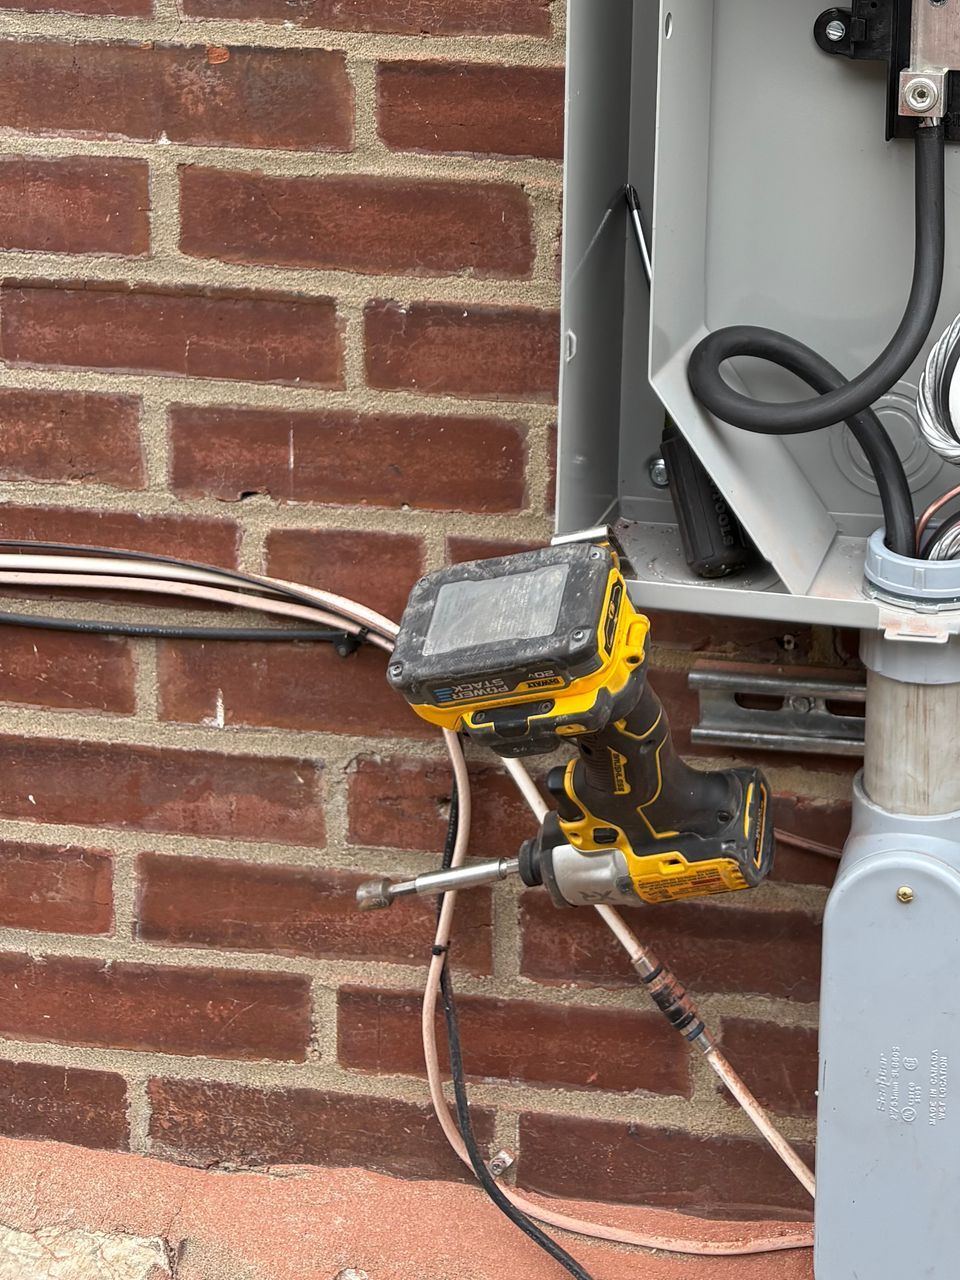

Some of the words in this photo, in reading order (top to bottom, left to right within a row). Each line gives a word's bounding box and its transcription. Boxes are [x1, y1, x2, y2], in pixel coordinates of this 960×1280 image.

[450, 678, 504, 692] STACK
[451, 685, 508, 700] POWER
[939, 1056, 947, 1098] LOCATION
[930, 1088, 937, 1097] IN
[938, 1101, 946, 1120] WET
